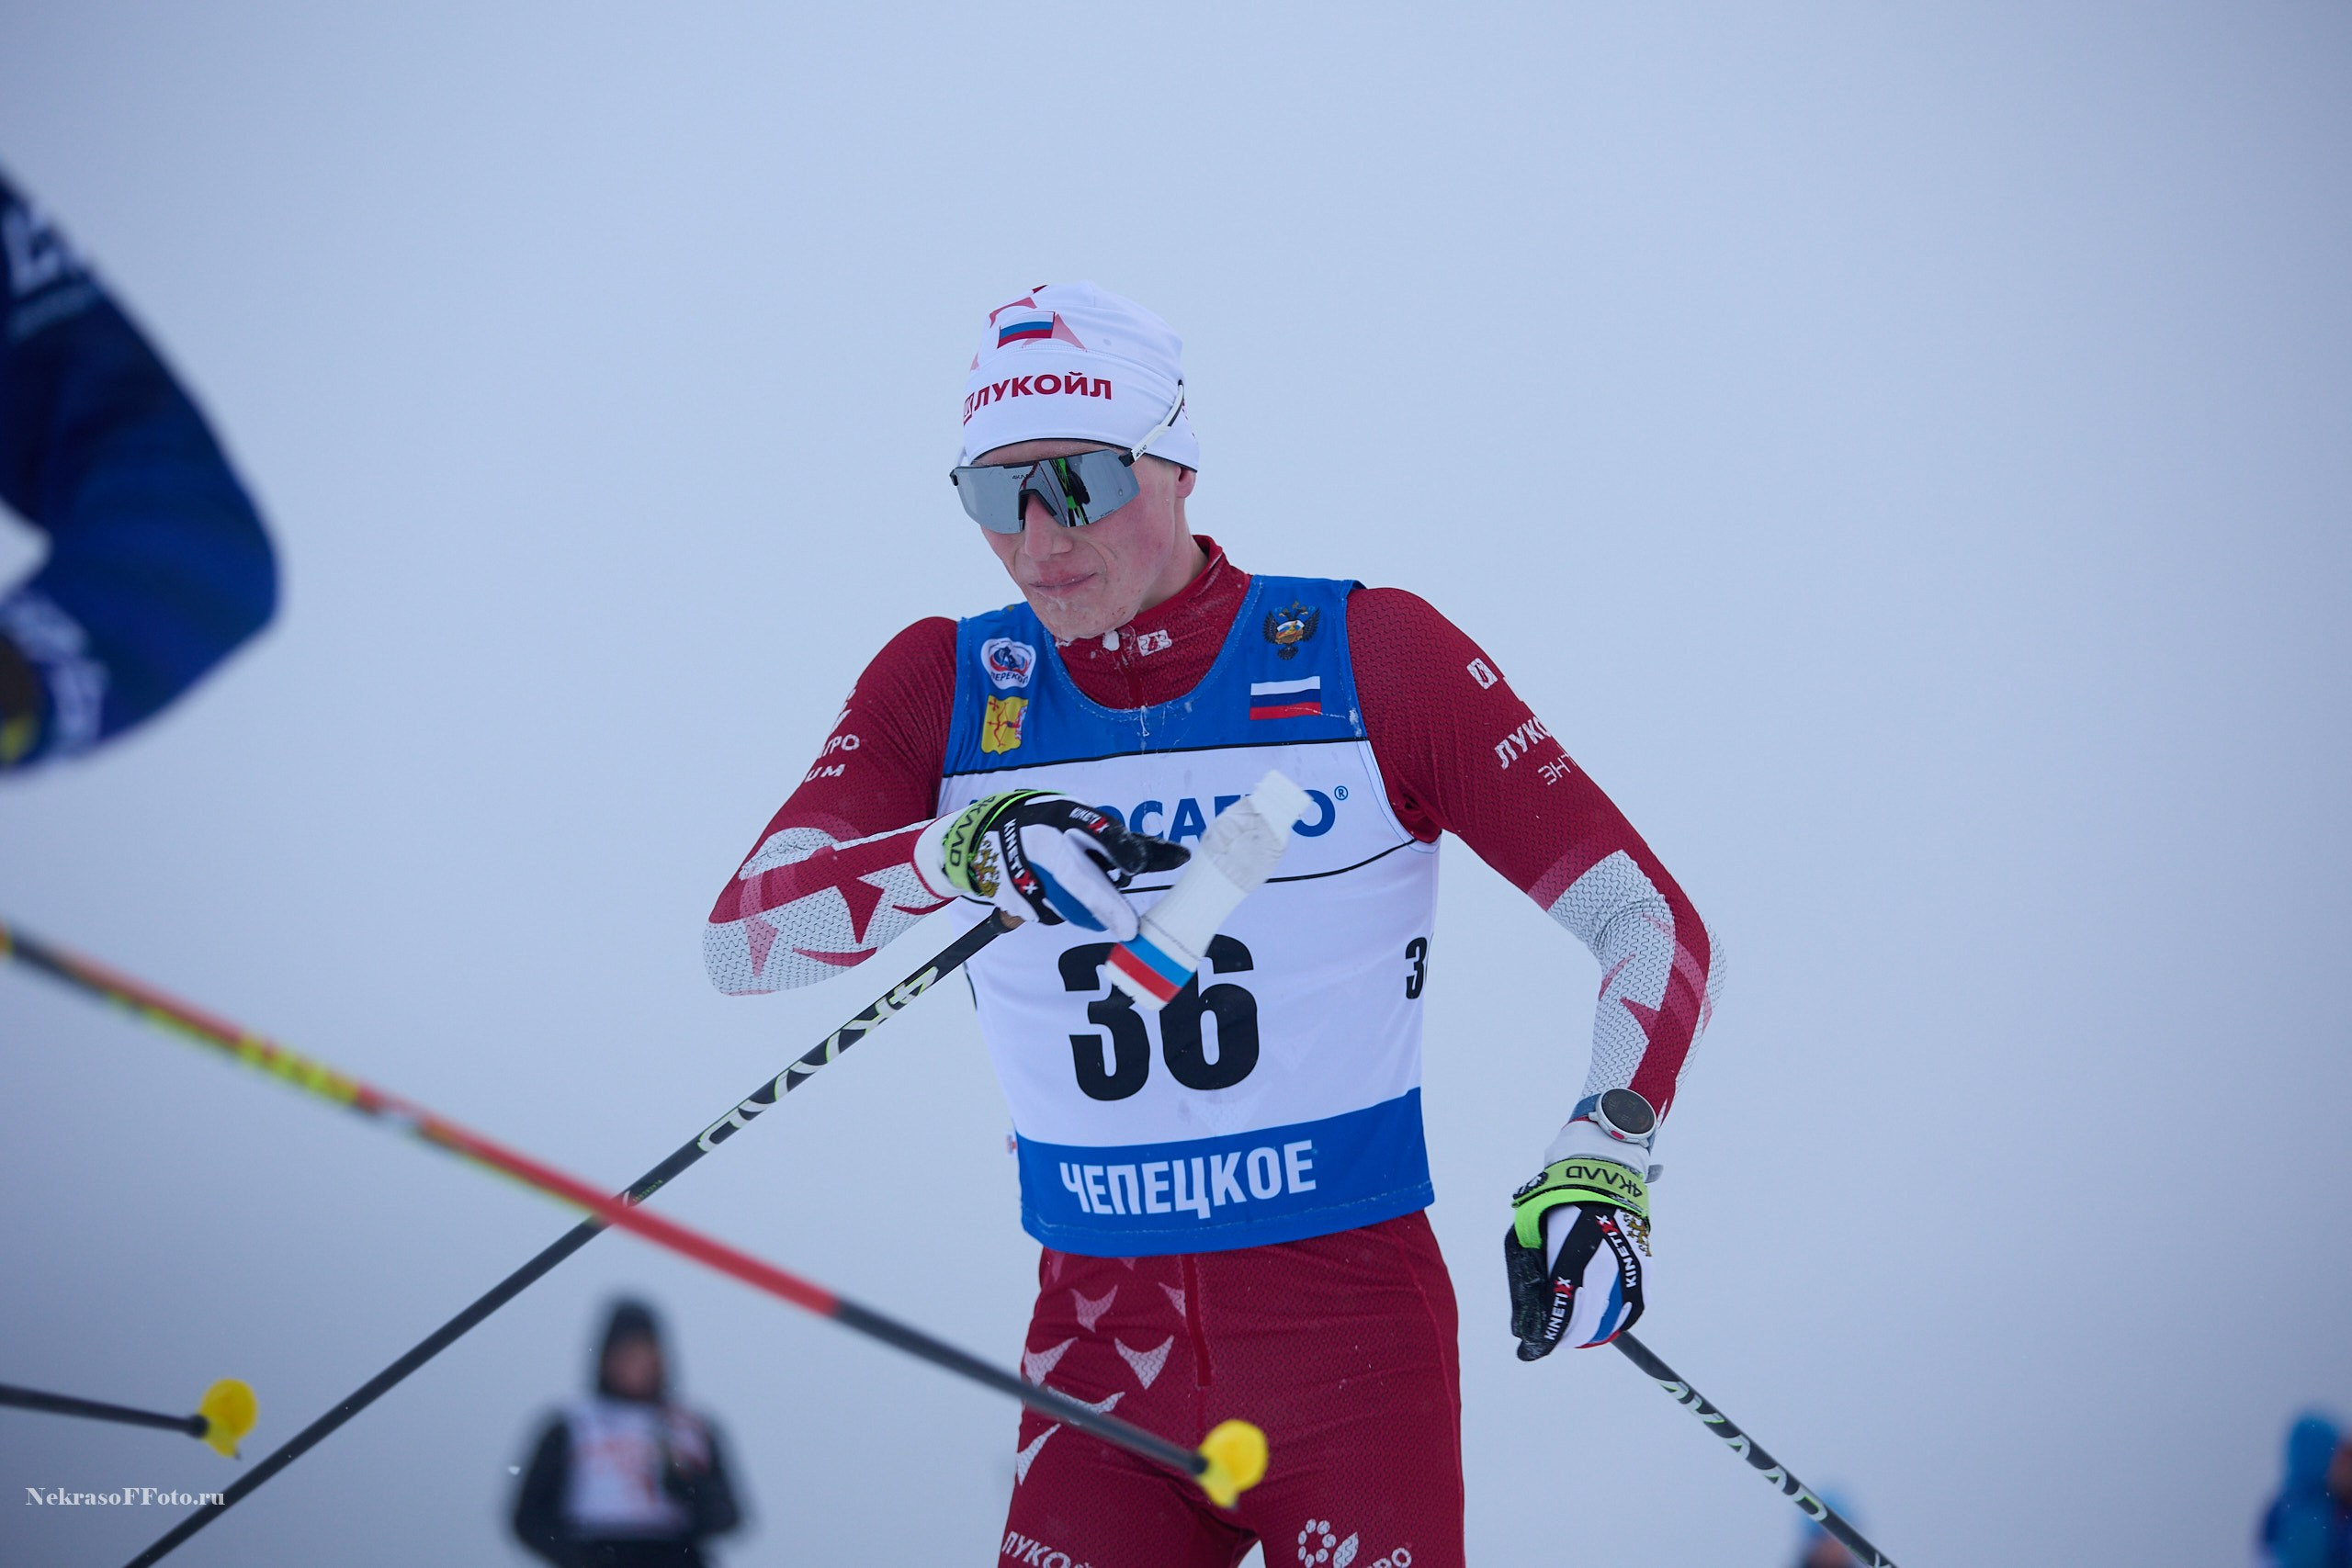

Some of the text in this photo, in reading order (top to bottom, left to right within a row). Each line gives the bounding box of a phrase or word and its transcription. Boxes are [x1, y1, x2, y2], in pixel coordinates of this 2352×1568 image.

[973, 371, 1113, 412] ЛУКОЙЛ
[991, 671, 1030, 684] ПЕРЕКОП
[1057, 933, 1261, 1101] 36
[1059, 1139, 1317, 1220] ЧЕПЕЦКОЕ
[1566, 1166, 1644, 1199] 4KAAD
